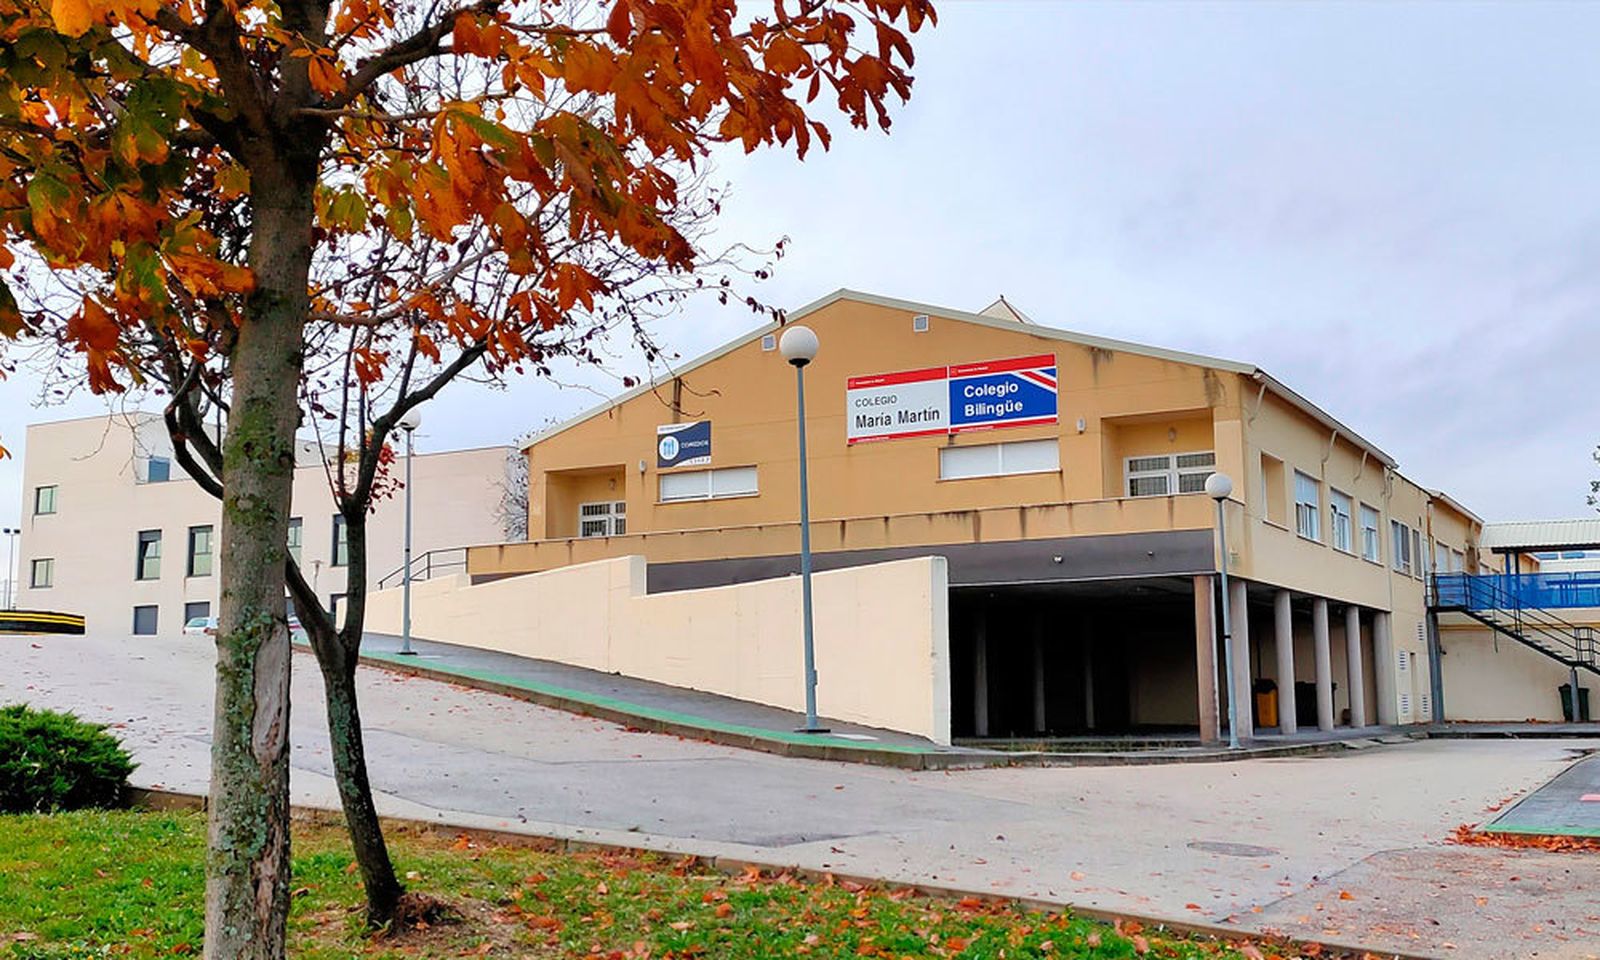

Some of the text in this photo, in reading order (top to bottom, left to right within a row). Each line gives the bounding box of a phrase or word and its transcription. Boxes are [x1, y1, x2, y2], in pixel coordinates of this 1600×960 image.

[964, 381, 1019, 398] Colegio
[855, 395, 898, 408] COLEGIO
[965, 400, 1023, 417] Bilingüe
[898, 407, 940, 424] Martín
